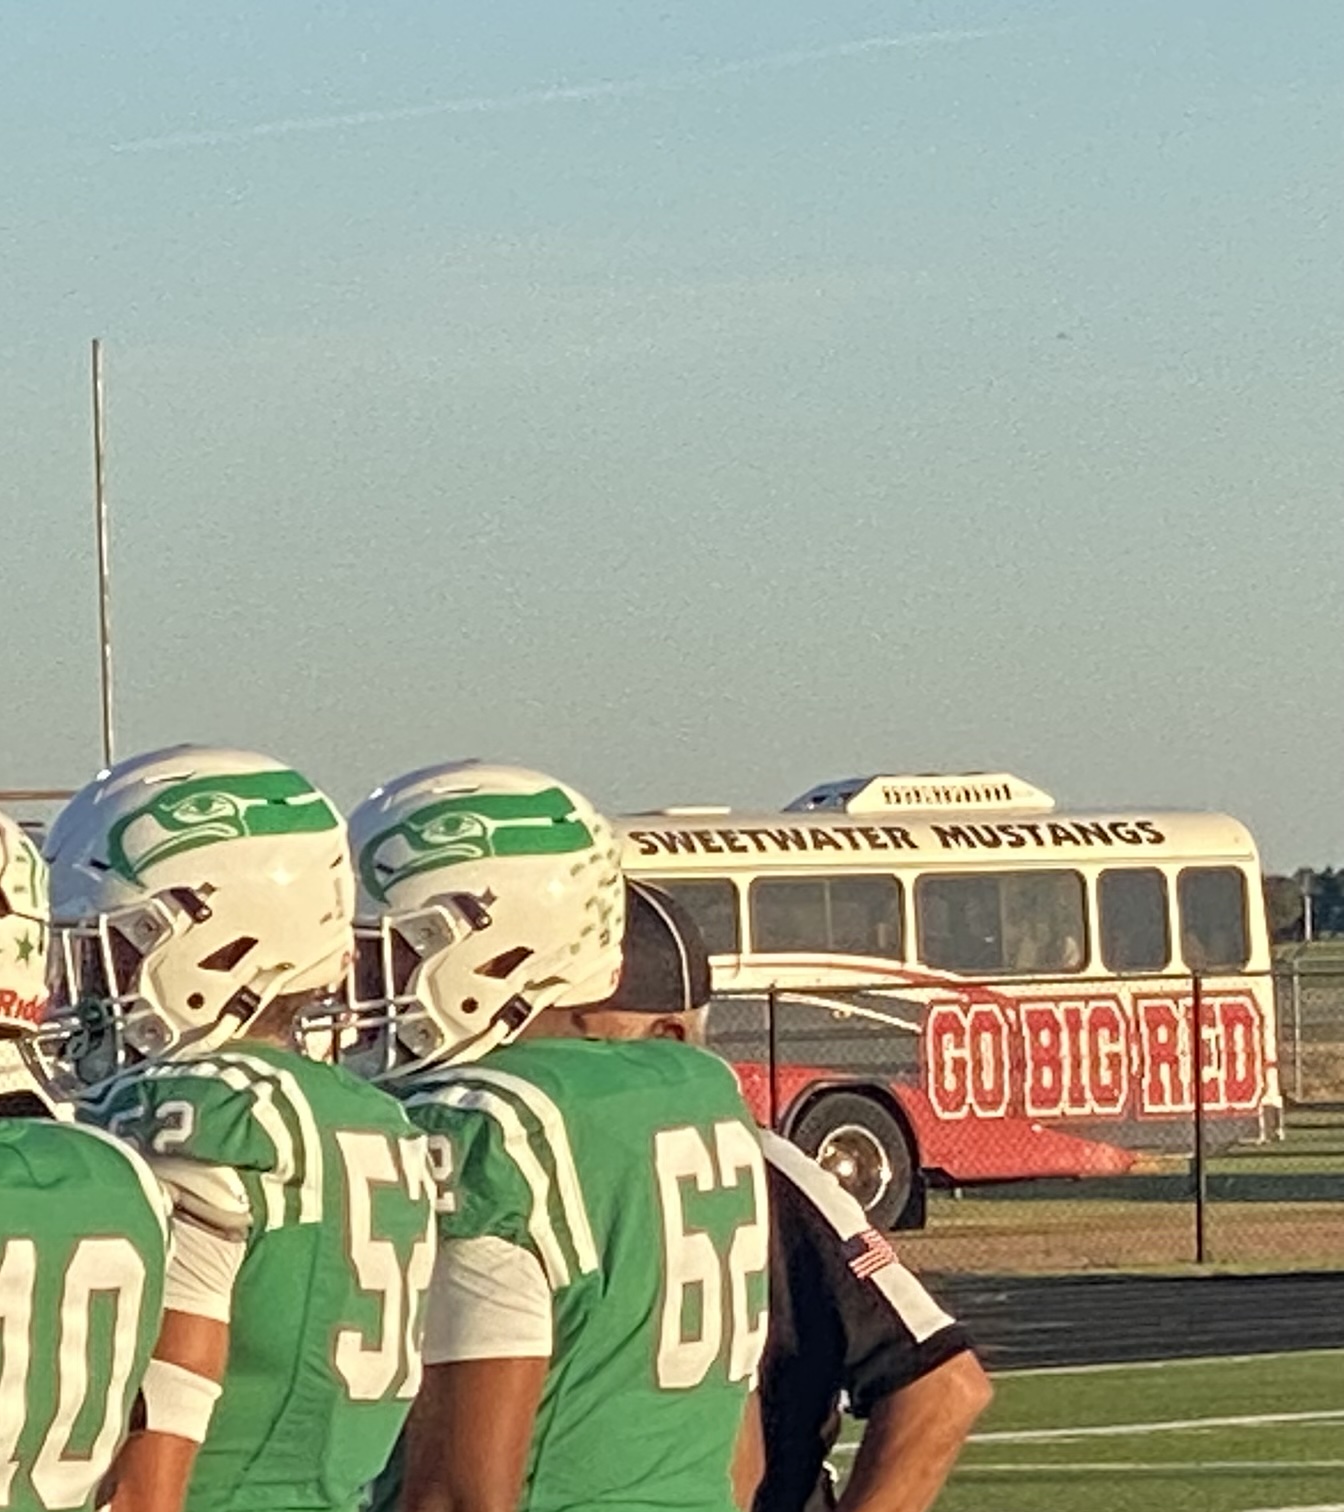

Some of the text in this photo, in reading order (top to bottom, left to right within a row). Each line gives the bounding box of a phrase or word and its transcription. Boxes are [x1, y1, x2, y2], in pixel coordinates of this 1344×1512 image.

[629, 821, 1166, 856] SWEETWATER MUSTANGS
[928, 996, 1261, 1119] GO BIG RED
[335, 1131, 437, 1399] 52
[655, 1120, 769, 1392] 62
